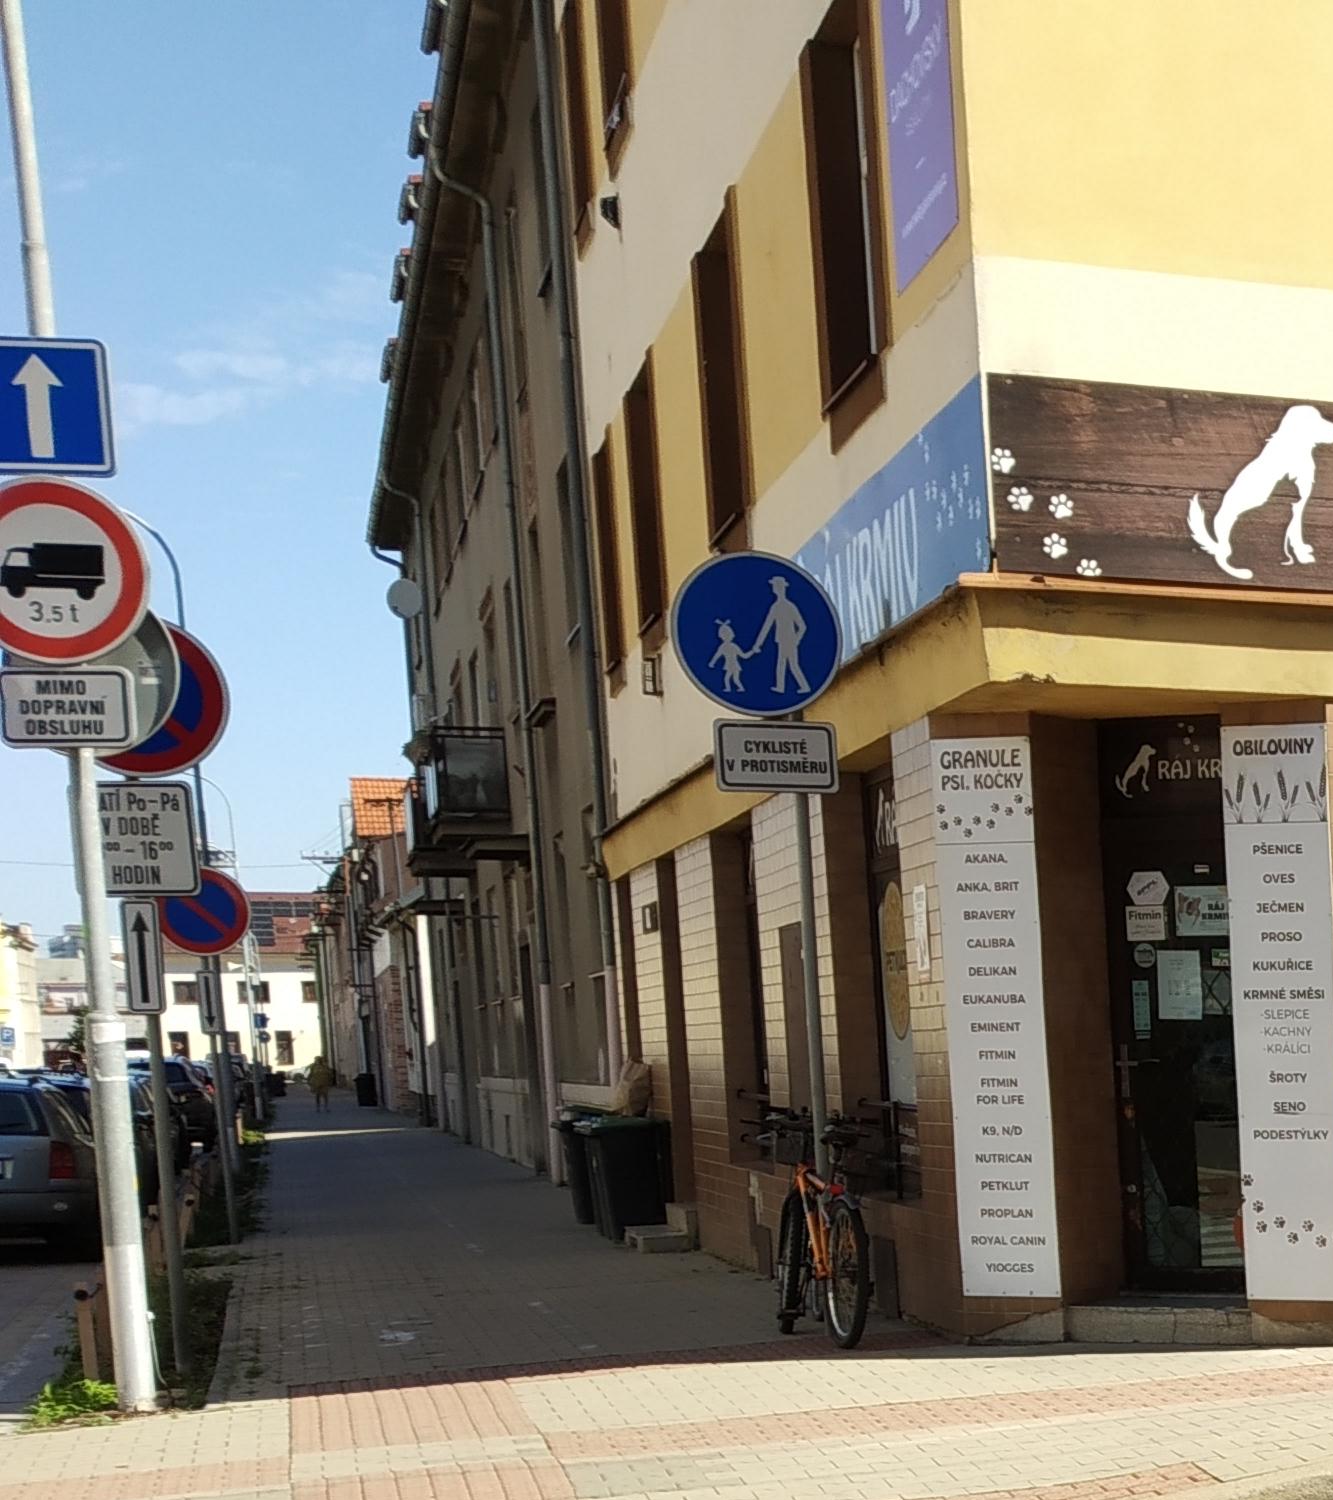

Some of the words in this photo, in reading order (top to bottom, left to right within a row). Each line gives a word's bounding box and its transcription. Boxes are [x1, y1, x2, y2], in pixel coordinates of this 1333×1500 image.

[846, 487, 919, 652] KRMIV
[69, 603, 80, 623] t
[36, 679, 87, 696] MIMO
[19, 695, 106, 716] DOPRAVNÍ
[25, 718, 104, 736] OBSLUHU
[743, 738, 808, 755] CYKLISTÉ
[1232, 736, 1315, 757] OBILOVINY
[940, 748, 1022, 770] GRANULE
[726, 759, 736, 772] V
[741, 757, 829, 775] PROTISMĚRU
[1157, 754, 1191, 780] RÁJ
[974, 769, 1024, 790] KOČKY
[118, 812, 161, 836] DOBĚ
[1252, 842, 1304, 855] PŠENICE
[112, 865, 162, 885] HODIN
[1262, 873, 1296, 884] OVES
[994, 881, 1020, 892] BRIT
[1256, 899, 1305, 914] JEČMEN
[963, 909, 1016, 921] BRAVERY
[1128, 910, 1162, 921] Fitmin
[966, 937, 1016, 949] CALIBRA
[1261, 931, 1303, 943] PROSO
[968, 966, 1017, 977] DELIKAN
[1252, 958, 1314, 972] KUKUŘICE
[962, 994, 1026, 1005] EUKANUBA
[1243, 987, 1287, 1000] KRMNÉ
[1289, 986, 1325, 1000] SMĚSI
[970, 1022, 1021, 1033] EMINENT
[978, 1050, 1017, 1061] FITMIN
[980, 1077, 1018, 1088] FITMIN
[1268, 1070, 1308, 1084] ŠROTY
[976, 1094, 999, 1105] FOR
[1001, 1094, 1025, 1105] LIFE
[1273, 1101, 1306, 1112] SENO
[1253, 1125, 1329, 1141] PODESTÝLKY
[975, 1153, 1033, 1164] NUTRICAN
[980, 1180, 1030, 1192] PETKLUT
[980, 1208, 1034, 1219] PROPLAN
[971, 1235, 1008, 1246] ROYAL
[1010, 1235, 1047, 1246] CANIN
